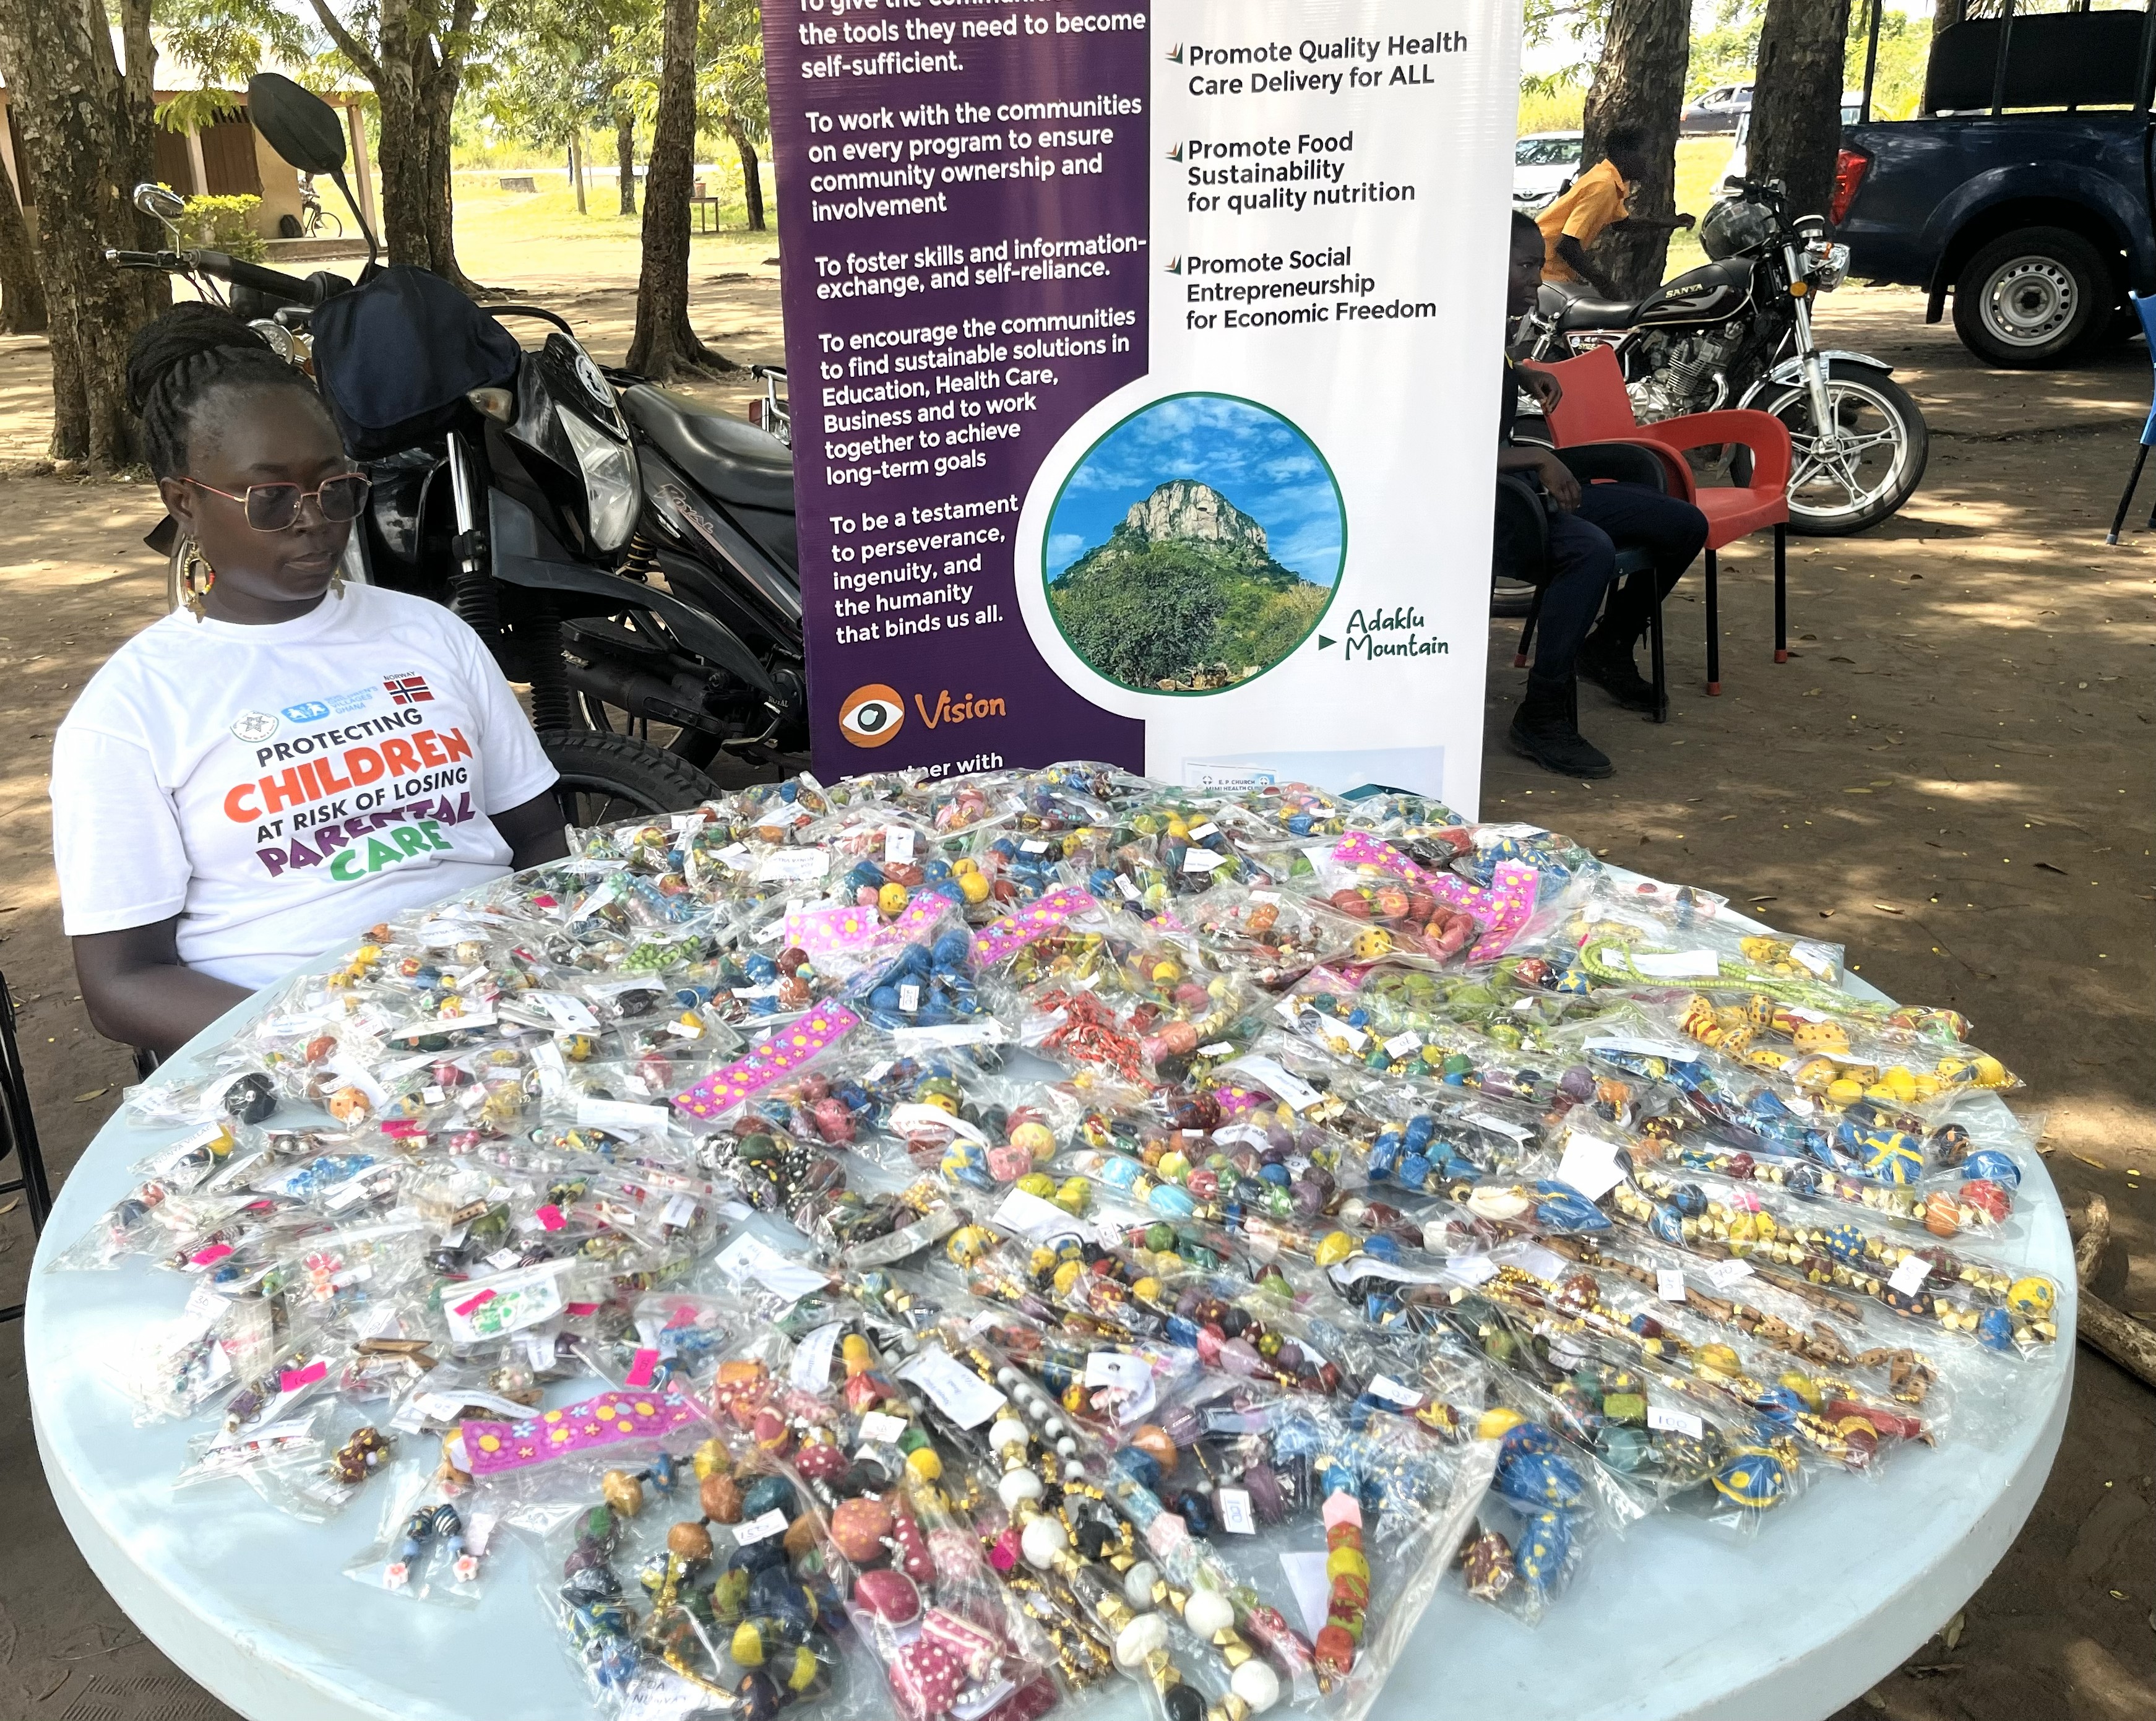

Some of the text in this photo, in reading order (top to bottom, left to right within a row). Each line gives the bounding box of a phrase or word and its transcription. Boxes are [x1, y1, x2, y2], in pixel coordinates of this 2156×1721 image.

[799, 12, 1145, 45] the tools they need to become
[802, 51, 963, 78] self-sufficient.
[1191, 31, 1467, 66] Promote Quality Health
[1189, 64, 1434, 95] Care Delivery for ALL
[806, 94, 1141, 132] To work with the communities
[809, 129, 1113, 162] on every program to ensure
[1189, 131, 1352, 159] Promote Food
[811, 153, 1102, 192] community ownership and
[1189, 159, 1345, 186] Sustainability
[813, 192, 947, 222] involvement
[1188, 182, 1414, 215] for quality nutrition
[815, 233, 1147, 276] To foster skills and information-
[1188, 246, 1350, 275] Promote Social
[817, 260, 1111, 300] exchange, and self-reliance.
[1188, 274, 1374, 304] Entrepreneurship
[1665, 283, 1704, 299] SANYA
[819, 308, 1135, 352] To encourage the communities
[1186, 300, 1436, 329] for Economic Freedom
[821, 334, 1129, 379] to find sustainable solutions in
[823, 368, 1058, 407] Education, Health Care,
[824, 392, 1037, 433] Business and to work
[825, 423, 1020, 461] together to achieve
[827, 449, 986, 486] long-term goals
[653, 483, 714, 535] ROYAL
[830, 494, 1019, 534] To be a testament
[832, 528, 1004, 563] to perseverance,
[834, 553, 981, 592] ingenuity, and
[835, 584, 973, 616] the humanity
[836, 605, 1003, 644] that binds us all.
[1346, 606, 1424, 634] Adaklu
[1346, 634, 1449, 660] Mountain
[383, 671, 416, 681] NORWAY
[330, 693, 373, 708] VILLAGES
[335, 702, 366, 714] GHANA
[768, 695, 790, 708] ROYAL
[915, 689, 1006, 729] Vision
[256, 708, 423, 768] PROTECTING
[223, 727, 473, 823] CHILDREN
[956, 753, 1003, 774] with
[257, 767, 468, 843] AT RISK OF LOSING
[256, 791, 476, 878] PARENTAL
[330, 821, 454, 881] CARE
[195, 1295, 209, 1306] 30
[1659, 1415, 1688, 1430] 100
[1227, 1499, 1243, 1524] 100
